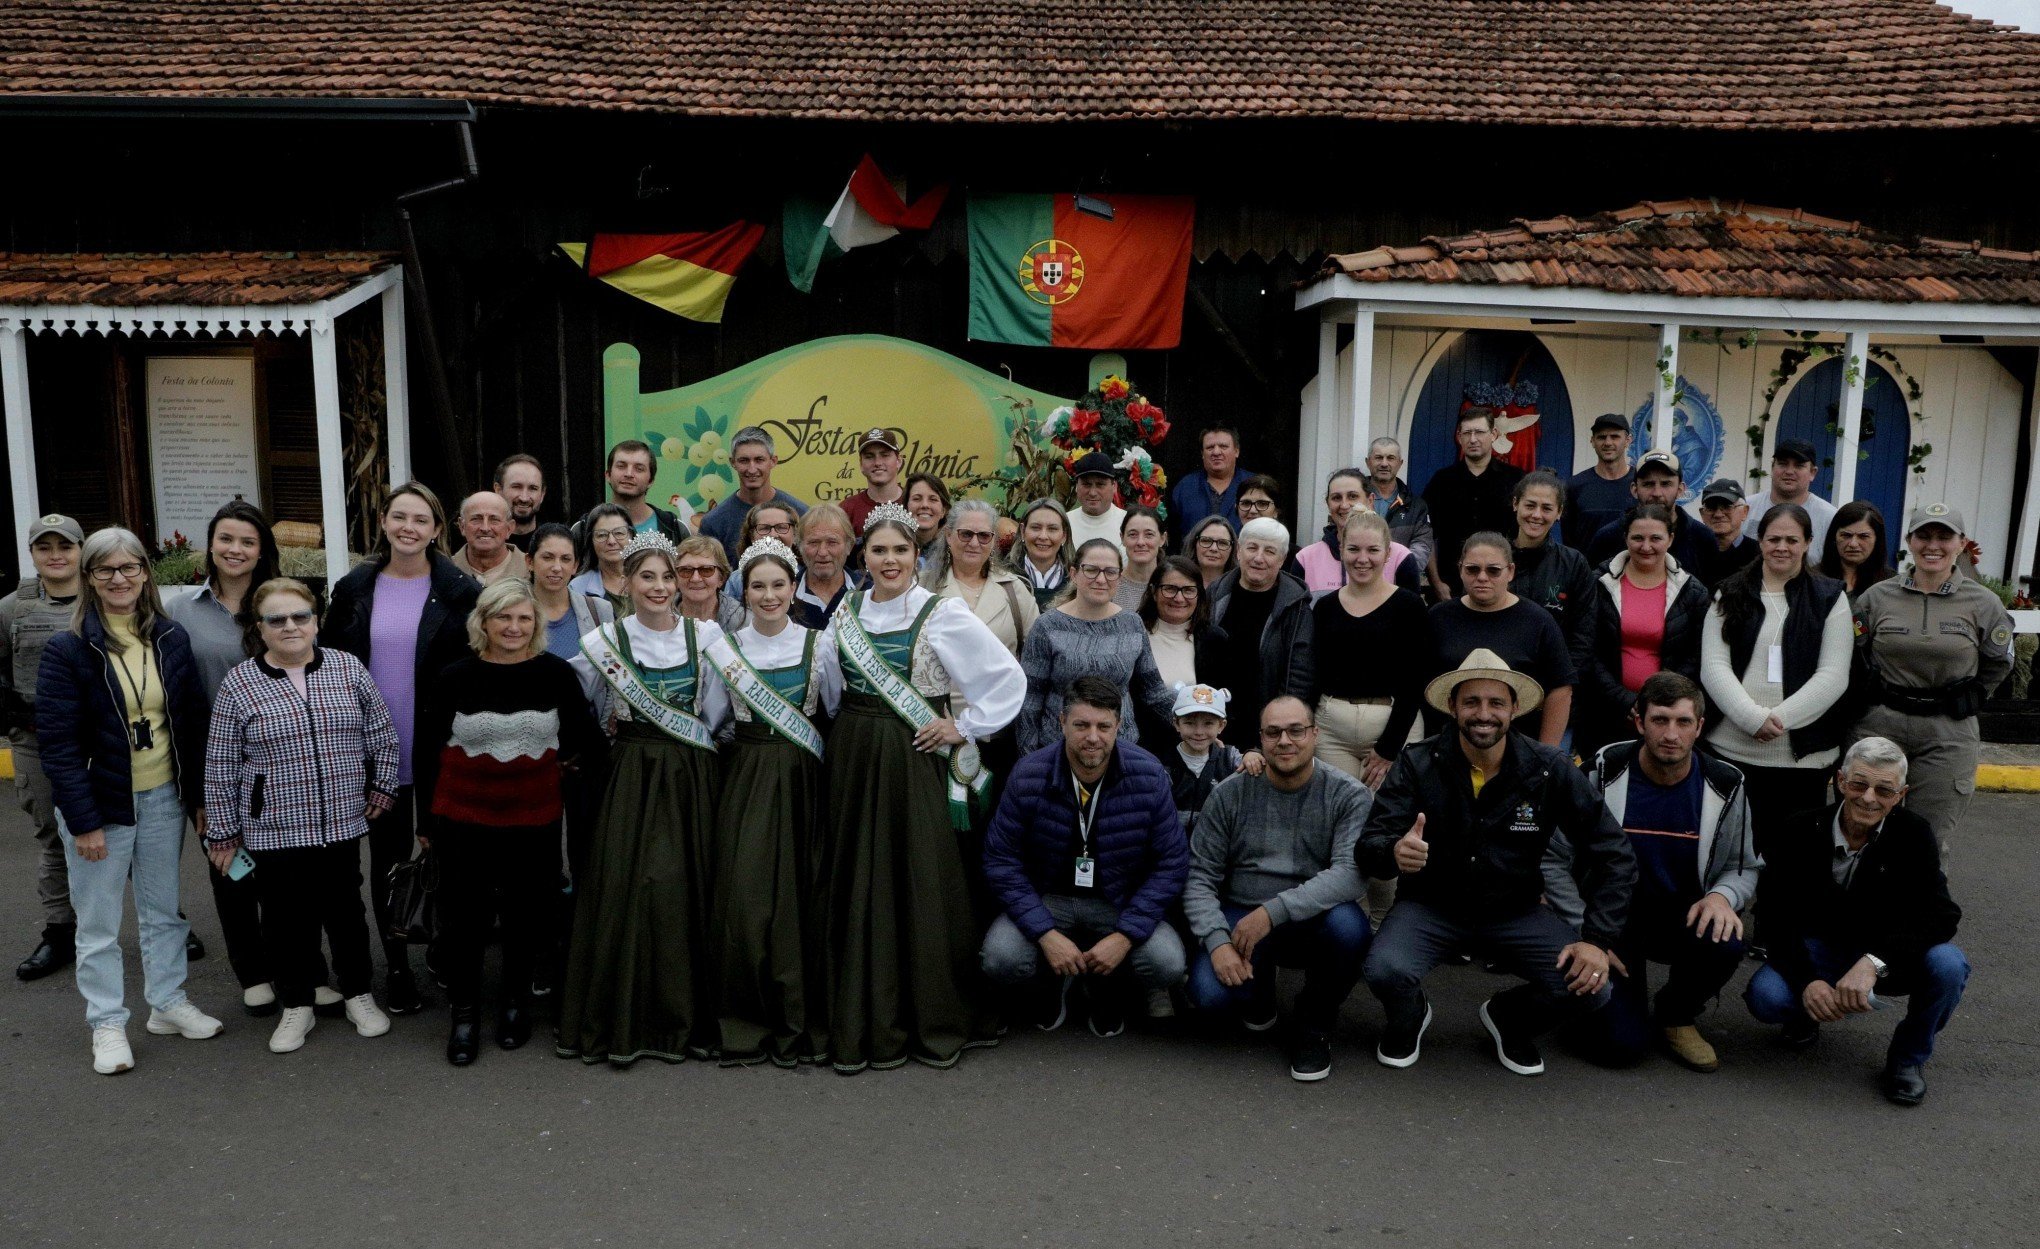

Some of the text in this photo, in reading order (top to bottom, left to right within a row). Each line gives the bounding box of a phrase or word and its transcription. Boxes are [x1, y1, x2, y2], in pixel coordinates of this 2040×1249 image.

[757, 395, 862, 465] Festa
[836, 461, 855, 480] da
[841, 616, 869, 661] PRINCESA
[862, 651, 892, 688] FESTA
[887, 681, 906, 703] DA
[622, 680, 668, 723] PRINCESA
[665, 713, 694, 738] FESTA
[745, 681, 787, 721] RAINHA
[783, 711, 812, 743] FESTA
